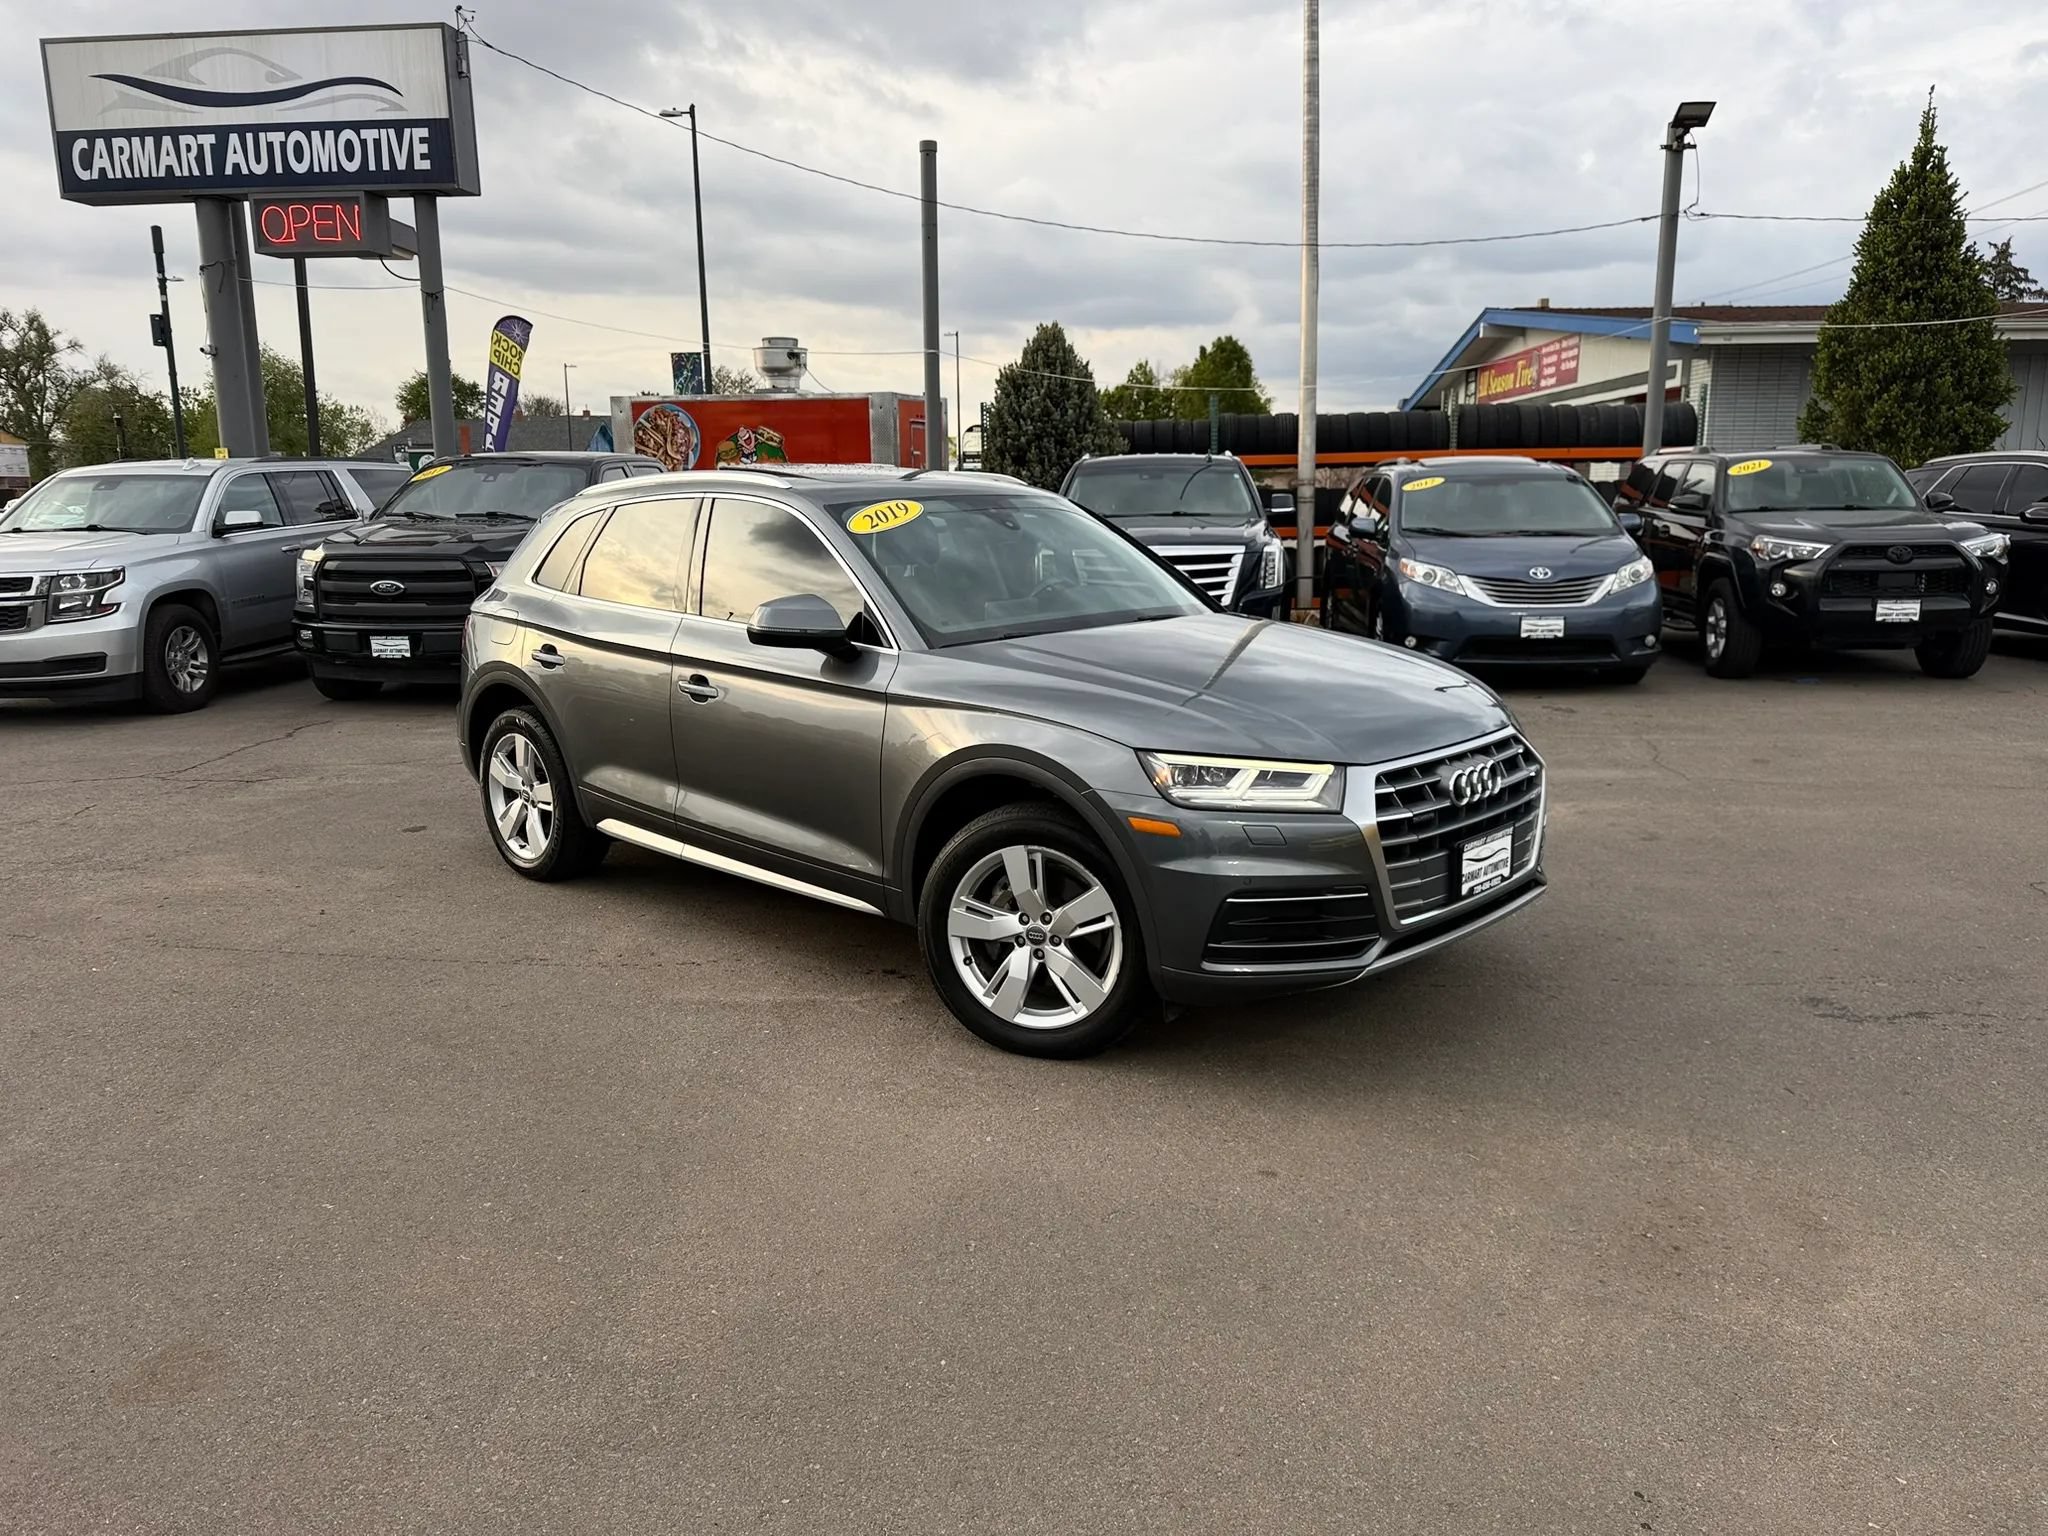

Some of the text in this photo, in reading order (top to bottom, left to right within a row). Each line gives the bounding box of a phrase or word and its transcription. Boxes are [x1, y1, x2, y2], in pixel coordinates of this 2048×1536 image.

[71, 127, 432, 182] CARMART AUTOMOTIVE
[261, 203, 361, 244] OPEN
[1488, 369, 1515, 395] Season
[1736, 461, 1762, 474] 2021
[862, 502, 909, 529] 2019
